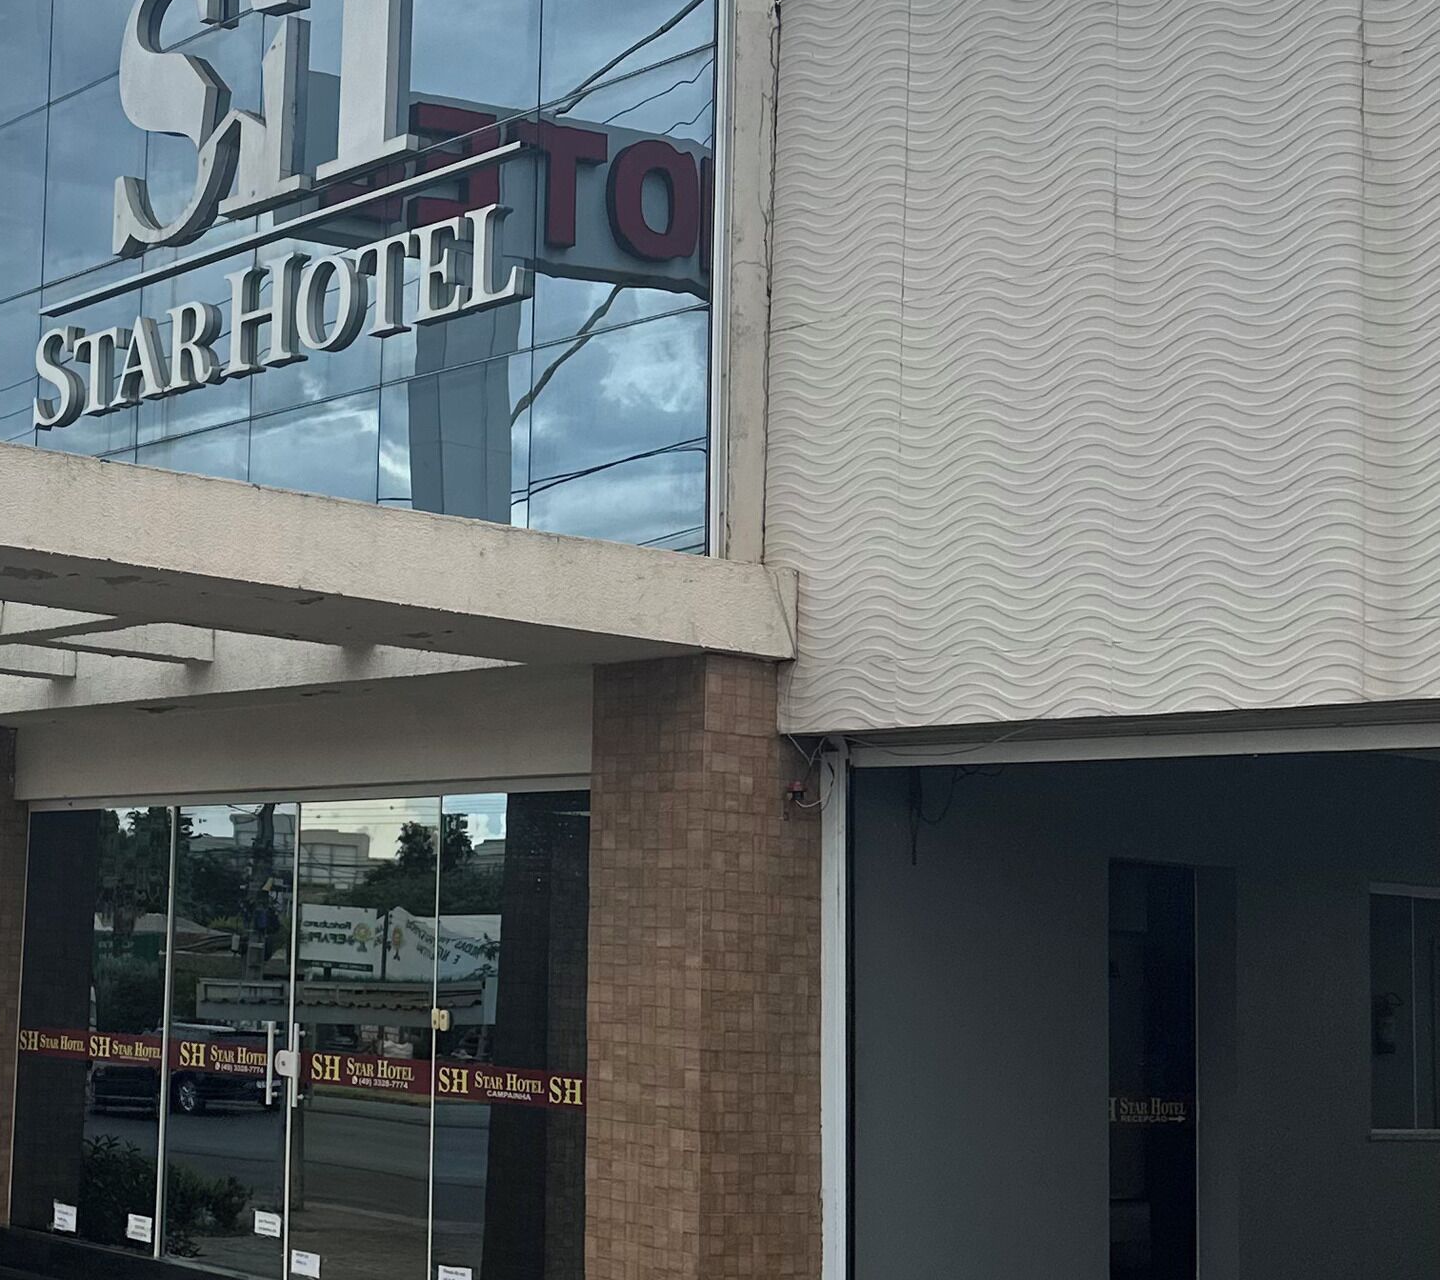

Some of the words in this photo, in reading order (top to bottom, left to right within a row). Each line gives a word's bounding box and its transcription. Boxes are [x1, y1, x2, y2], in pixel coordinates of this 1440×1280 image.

[32, 299, 222, 430] STAR
[220, 203, 534, 379] HOTEL
[19, 1030, 39, 1051] SH
[89, 1035, 111, 1058] SH
[179, 1041, 206, 1068] SH
[210, 1046, 235, 1064] STAR
[311, 1053, 341, 1081] SH
[346, 1057, 374, 1077] STAR
[377, 1059, 415, 1081] HOTEL
[438, 1066, 469, 1094] SH
[474, 1070, 503, 1091] STAR
[505, 1072, 545, 1094] HOTEL
[548, 1076, 583, 1105] SH
